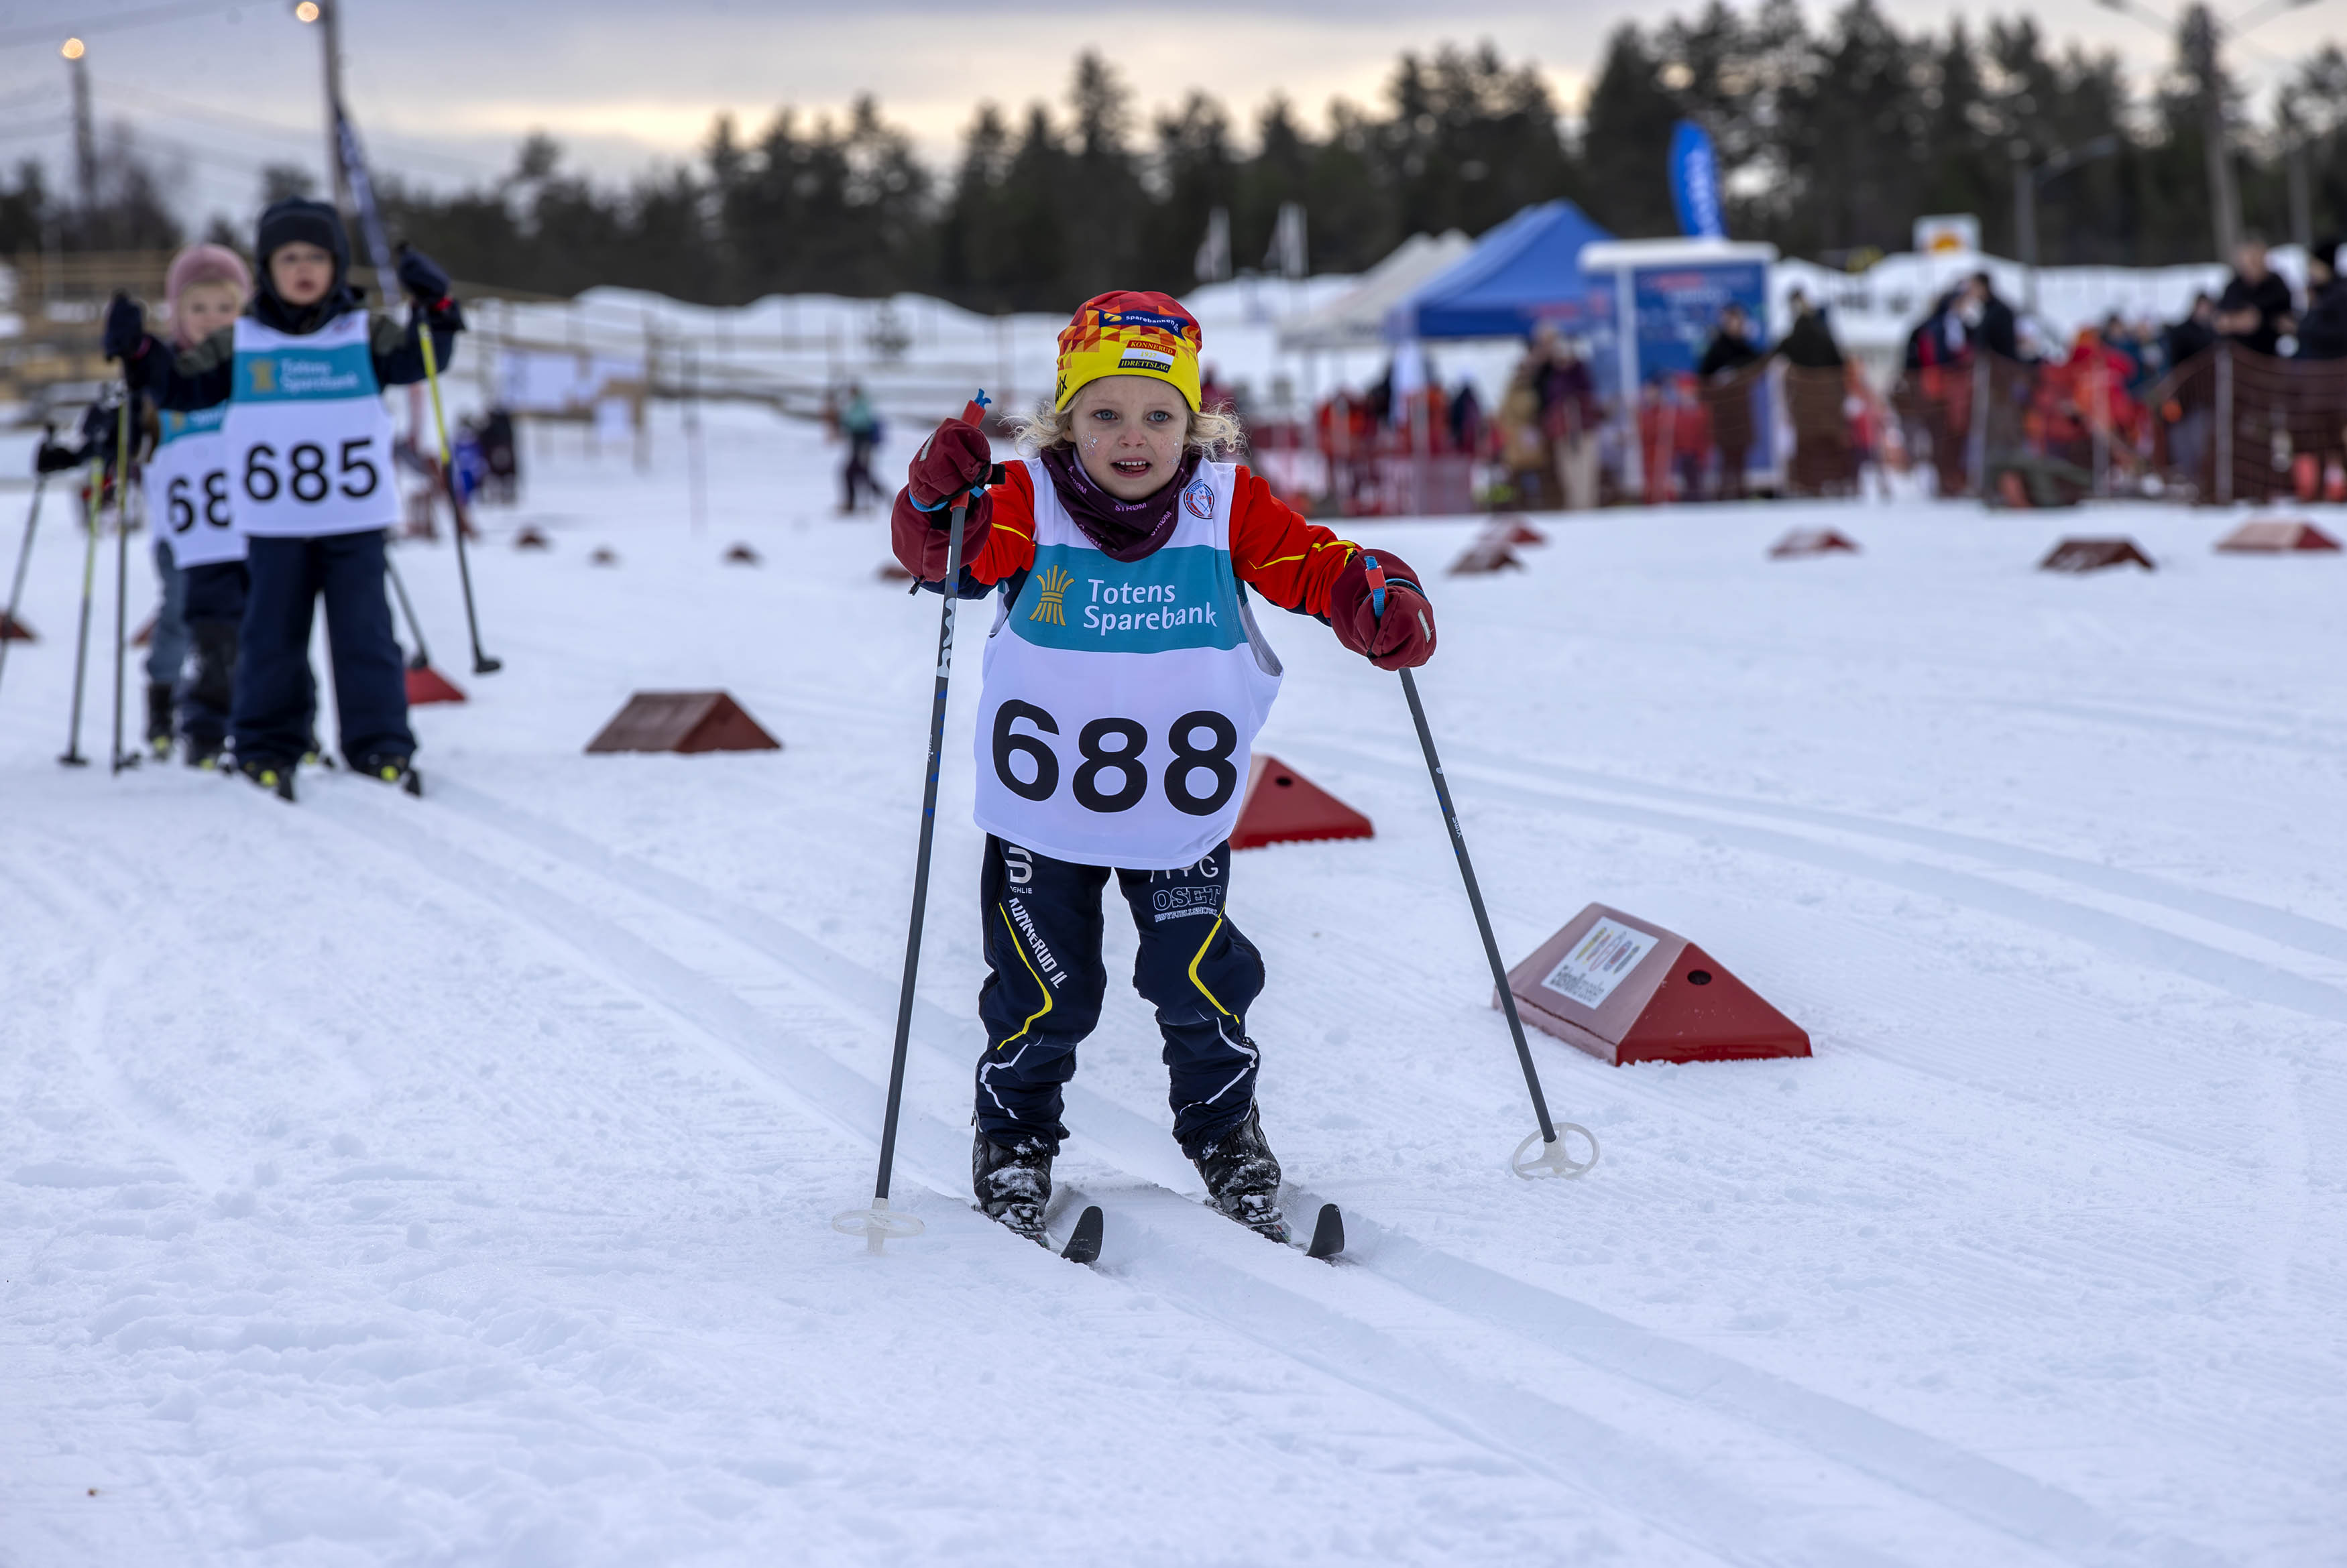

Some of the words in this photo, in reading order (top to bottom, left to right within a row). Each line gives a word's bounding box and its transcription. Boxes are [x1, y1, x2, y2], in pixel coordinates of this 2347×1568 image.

[1130, 341, 1174, 355] KONNERUD
[1140, 351, 1157, 359] 1927
[1121, 360, 1169, 371] IDRETTSLAG
[1055, 373, 1068, 404] wix
[244, 436, 379, 503] 685
[168, 469, 231, 534] 68
[1088, 579, 1176, 605] Totens
[1083, 601, 1217, 636] Sparebank
[992, 699, 1237, 817] 688
[1153, 884, 1222, 911] OSET
[1049, 971, 1068, 989] IL
